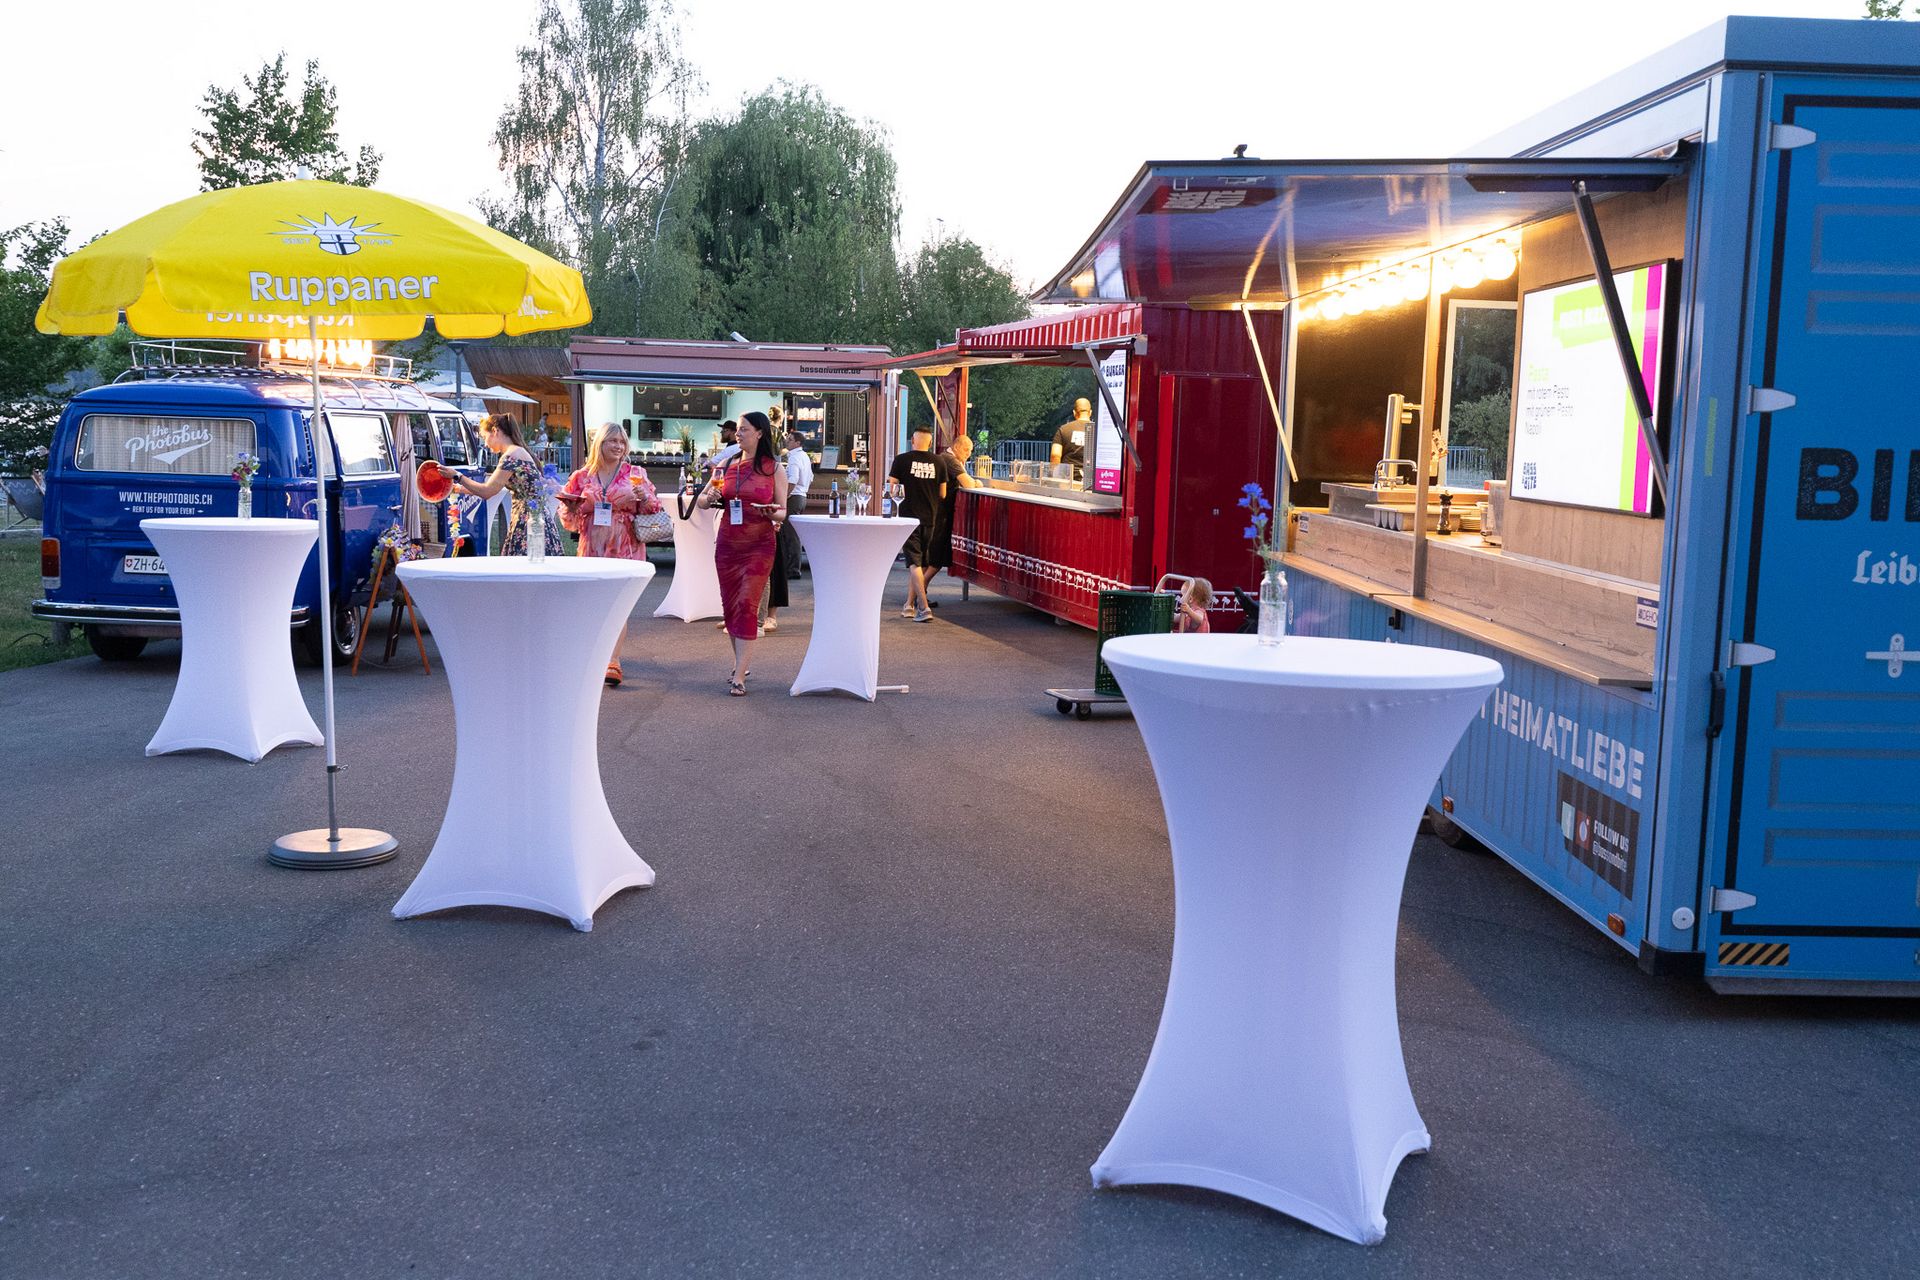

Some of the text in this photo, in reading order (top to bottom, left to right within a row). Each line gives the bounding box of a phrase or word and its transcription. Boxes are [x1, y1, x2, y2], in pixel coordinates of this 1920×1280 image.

[249, 271, 439, 306] Ruppaner
[125, 425, 212, 463] Photobus
[152, 425, 169, 438] the
[119, 491, 213, 505] WWW.THEPHOTOBUS.CH
[1797, 448, 1920, 522] BI
[132, 505, 145, 513] RENT
[146, 506, 153, 514] US
[165, 507, 179, 515] YOUR
[180, 507, 195, 515] EVENT
[1852, 550, 1920, 586] Leib
[1493, 687, 1644, 800] HEIMATLIEBE
[1593, 819, 1630, 853] FOLLOW US
